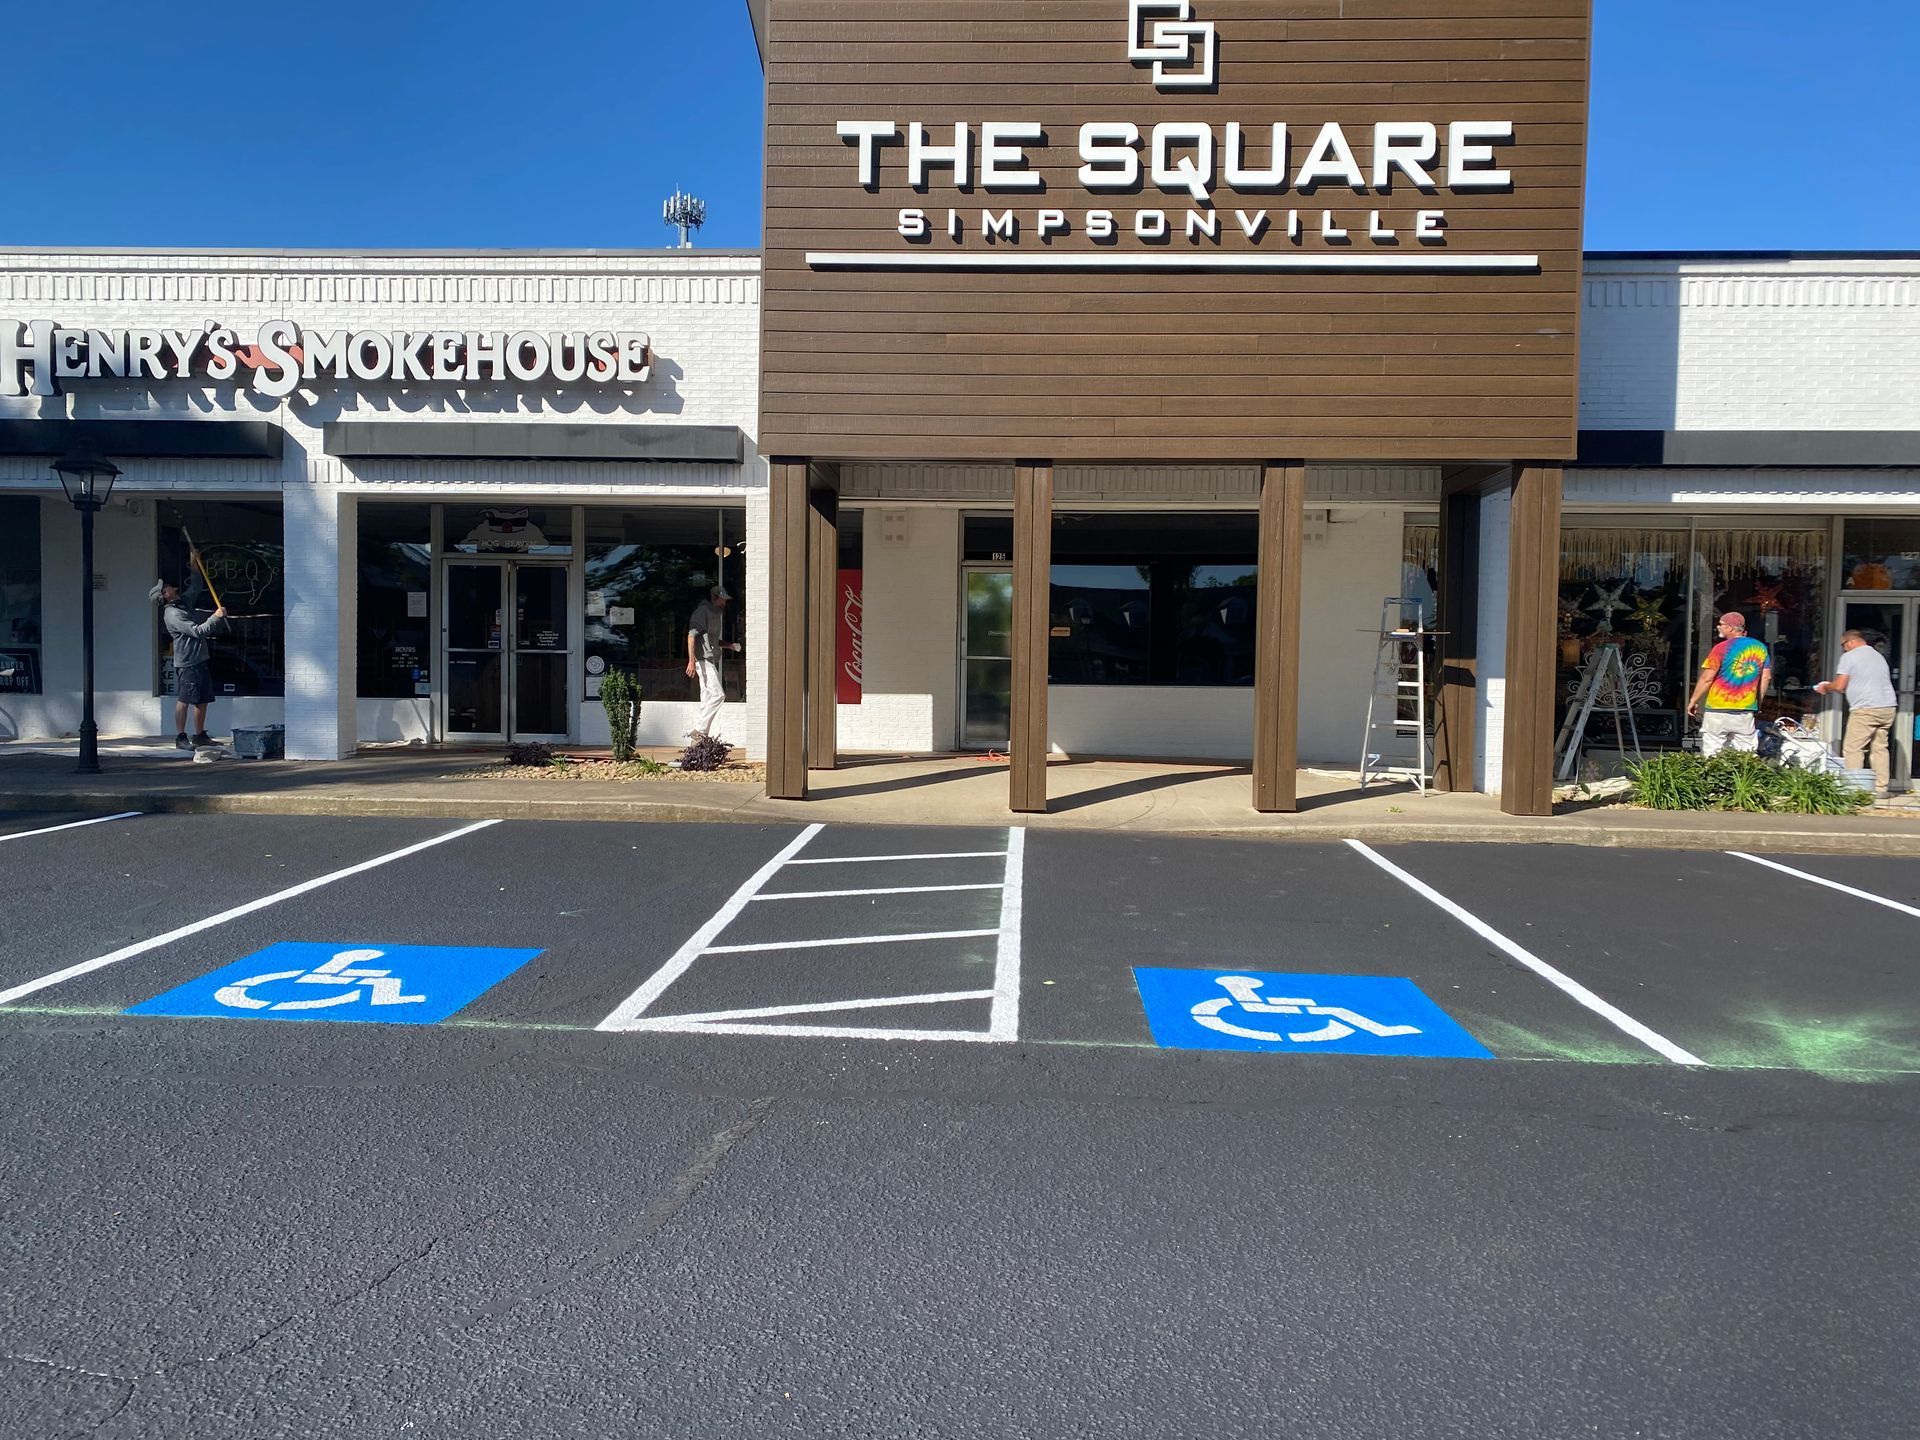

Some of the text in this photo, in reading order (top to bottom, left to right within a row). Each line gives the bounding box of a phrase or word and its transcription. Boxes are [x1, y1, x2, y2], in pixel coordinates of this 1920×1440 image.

[836, 120, 1513, 201] THE SQUARE
[897, 207, 1446, 239] SIMPSONVILLE
[0, 319, 651, 398] HENRY'S SMOKEHOUSE
